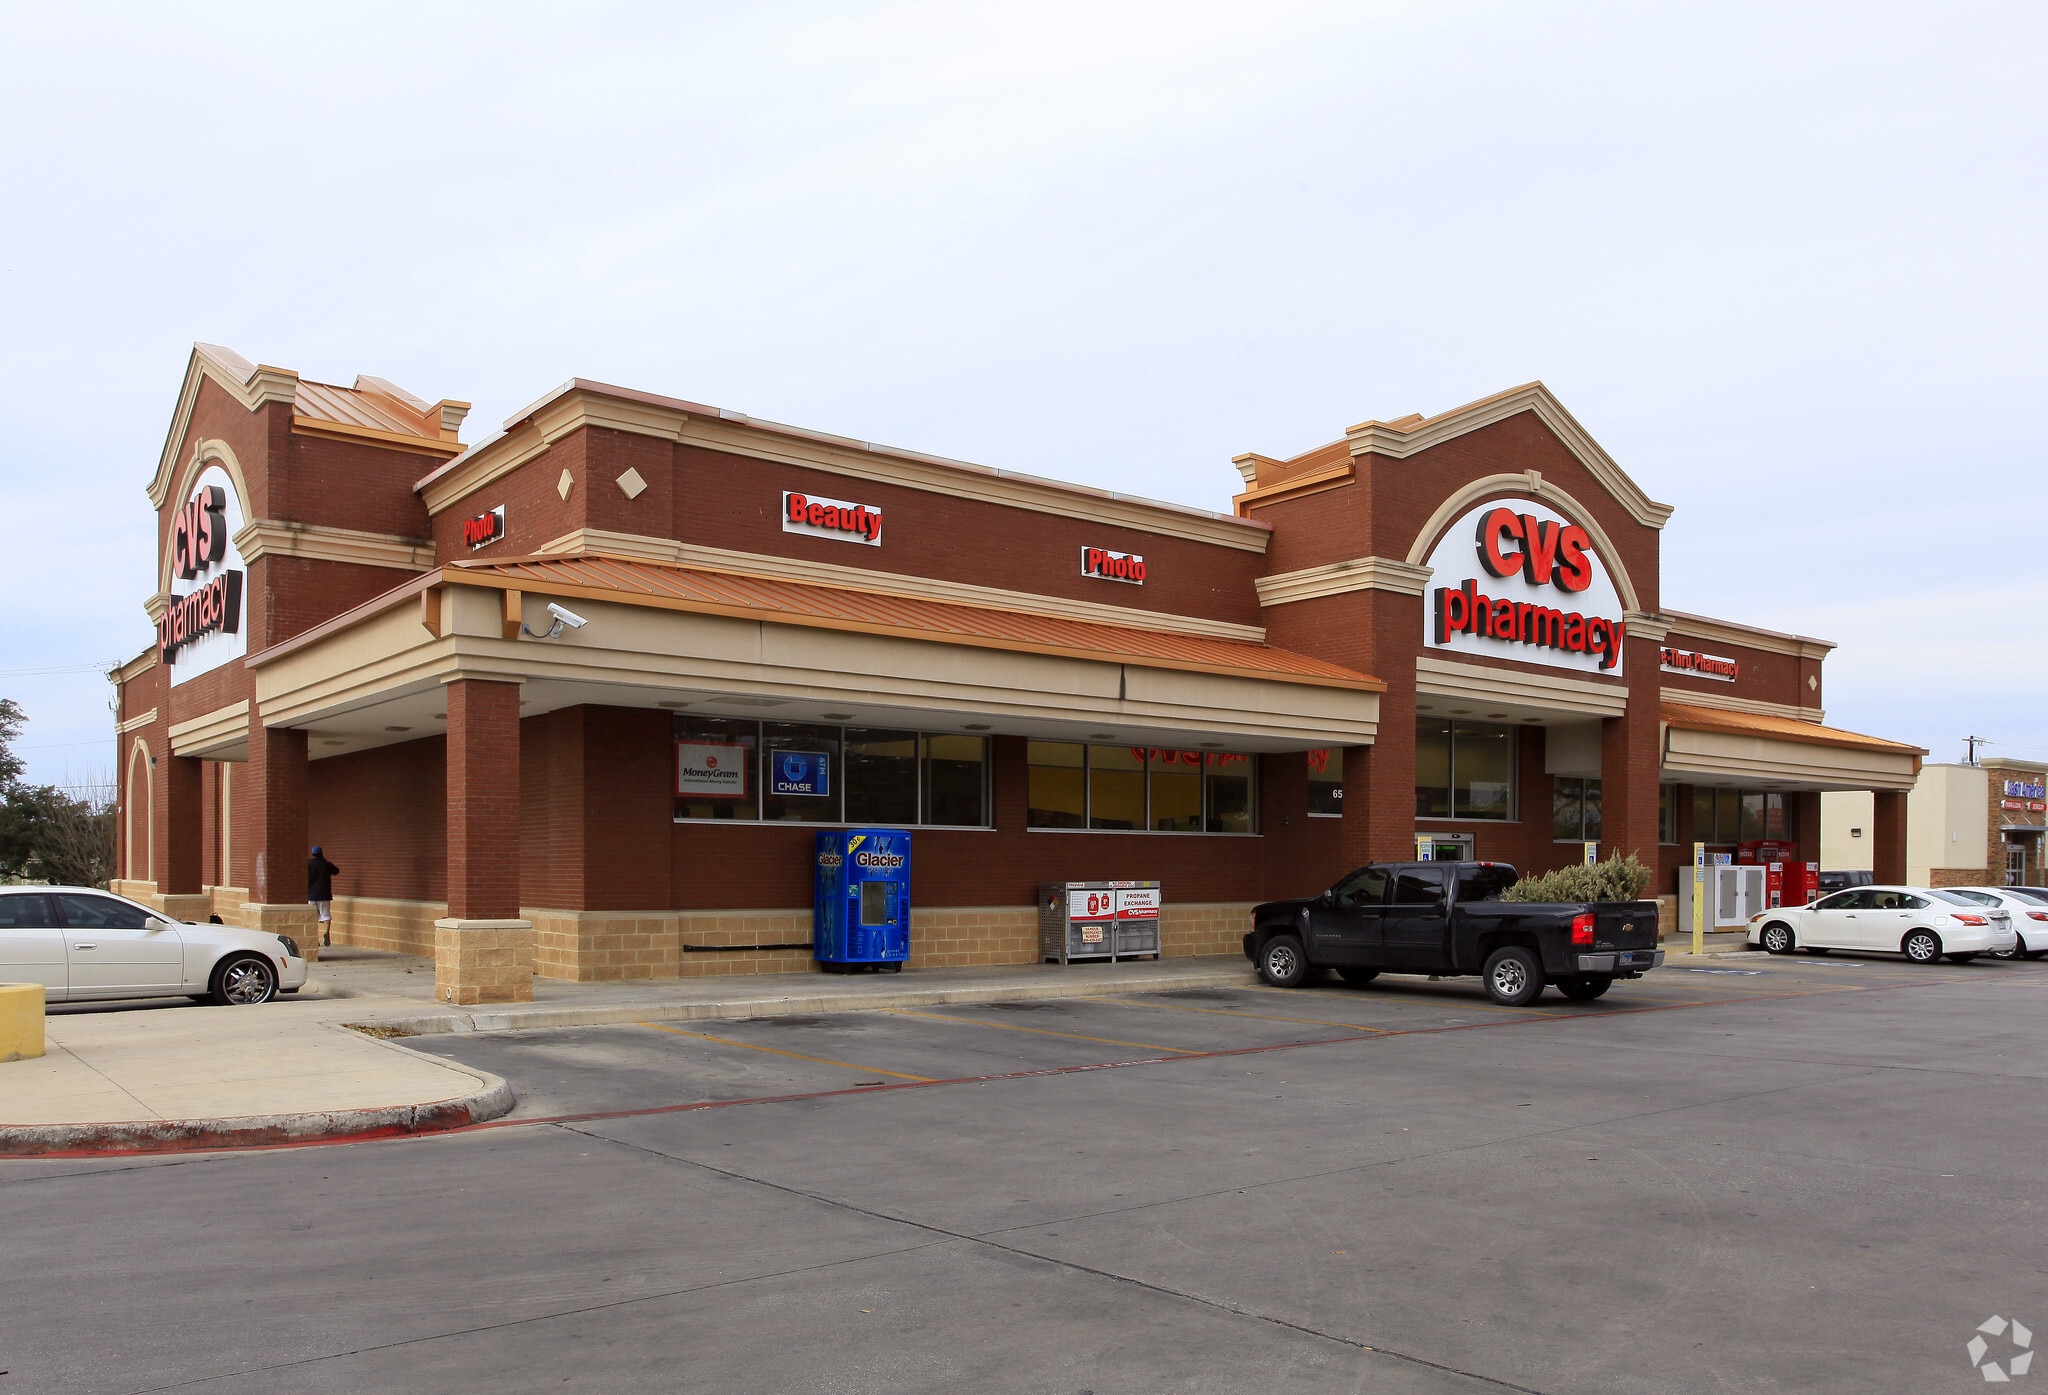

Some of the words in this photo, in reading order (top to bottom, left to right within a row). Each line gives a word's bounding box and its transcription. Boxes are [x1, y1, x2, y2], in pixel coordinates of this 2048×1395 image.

[174, 485, 222, 579] CVS
[464, 511, 497, 546] Photo
[787, 493, 882, 540] Beauty
[1087, 548, 1146, 580] Photo
[1480, 507, 1592, 593] CVS
[161, 569, 238, 664] pharmacy
[1438, 578, 1625, 669] pharmacy
[1694, 653, 1739, 680] Pharmacy
[682, 767, 738, 778] MoneyGram
[778, 782, 812, 792] CHASE
[818, 853, 842, 866] Glacier
[857, 852, 904, 867] Glacier
